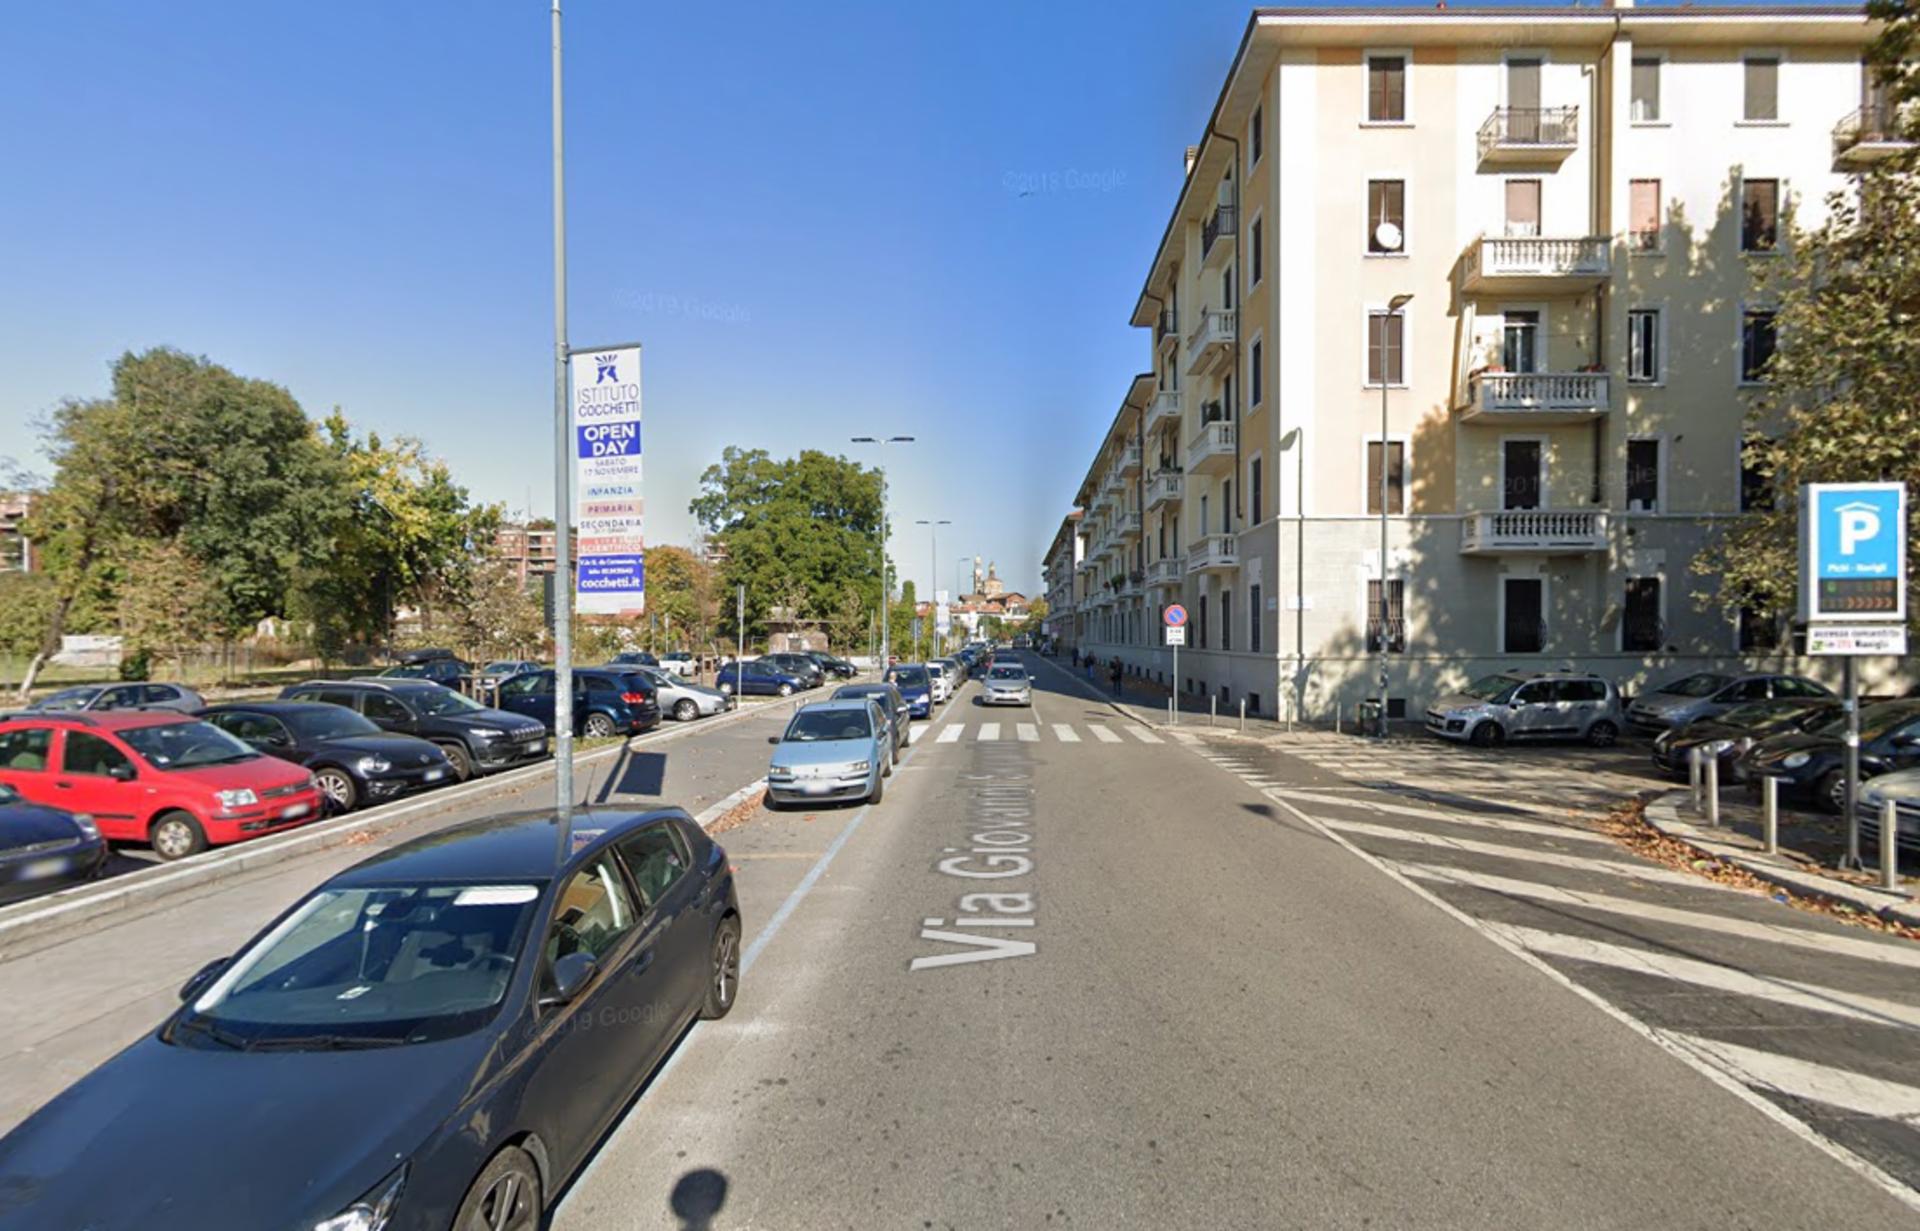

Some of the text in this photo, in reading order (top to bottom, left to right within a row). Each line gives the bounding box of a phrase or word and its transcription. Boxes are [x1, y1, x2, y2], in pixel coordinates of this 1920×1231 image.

[577, 384, 640, 404] ISTITUTO
[578, 400, 640, 417] COCCHETTI
[584, 423, 636, 442] OPEN
[592, 440, 629, 457] DAY
[594, 458, 627, 467] SABATO
[594, 465, 639, 475] NOVEMBRE
[587, 486, 634, 496] INFANZIA
[587, 504, 634, 513] PRIMARIA
[580, 519, 642, 529] SECONDARIA
[1840, 511, 1881, 555] P
[581, 576, 641, 589] cocchetti.it
